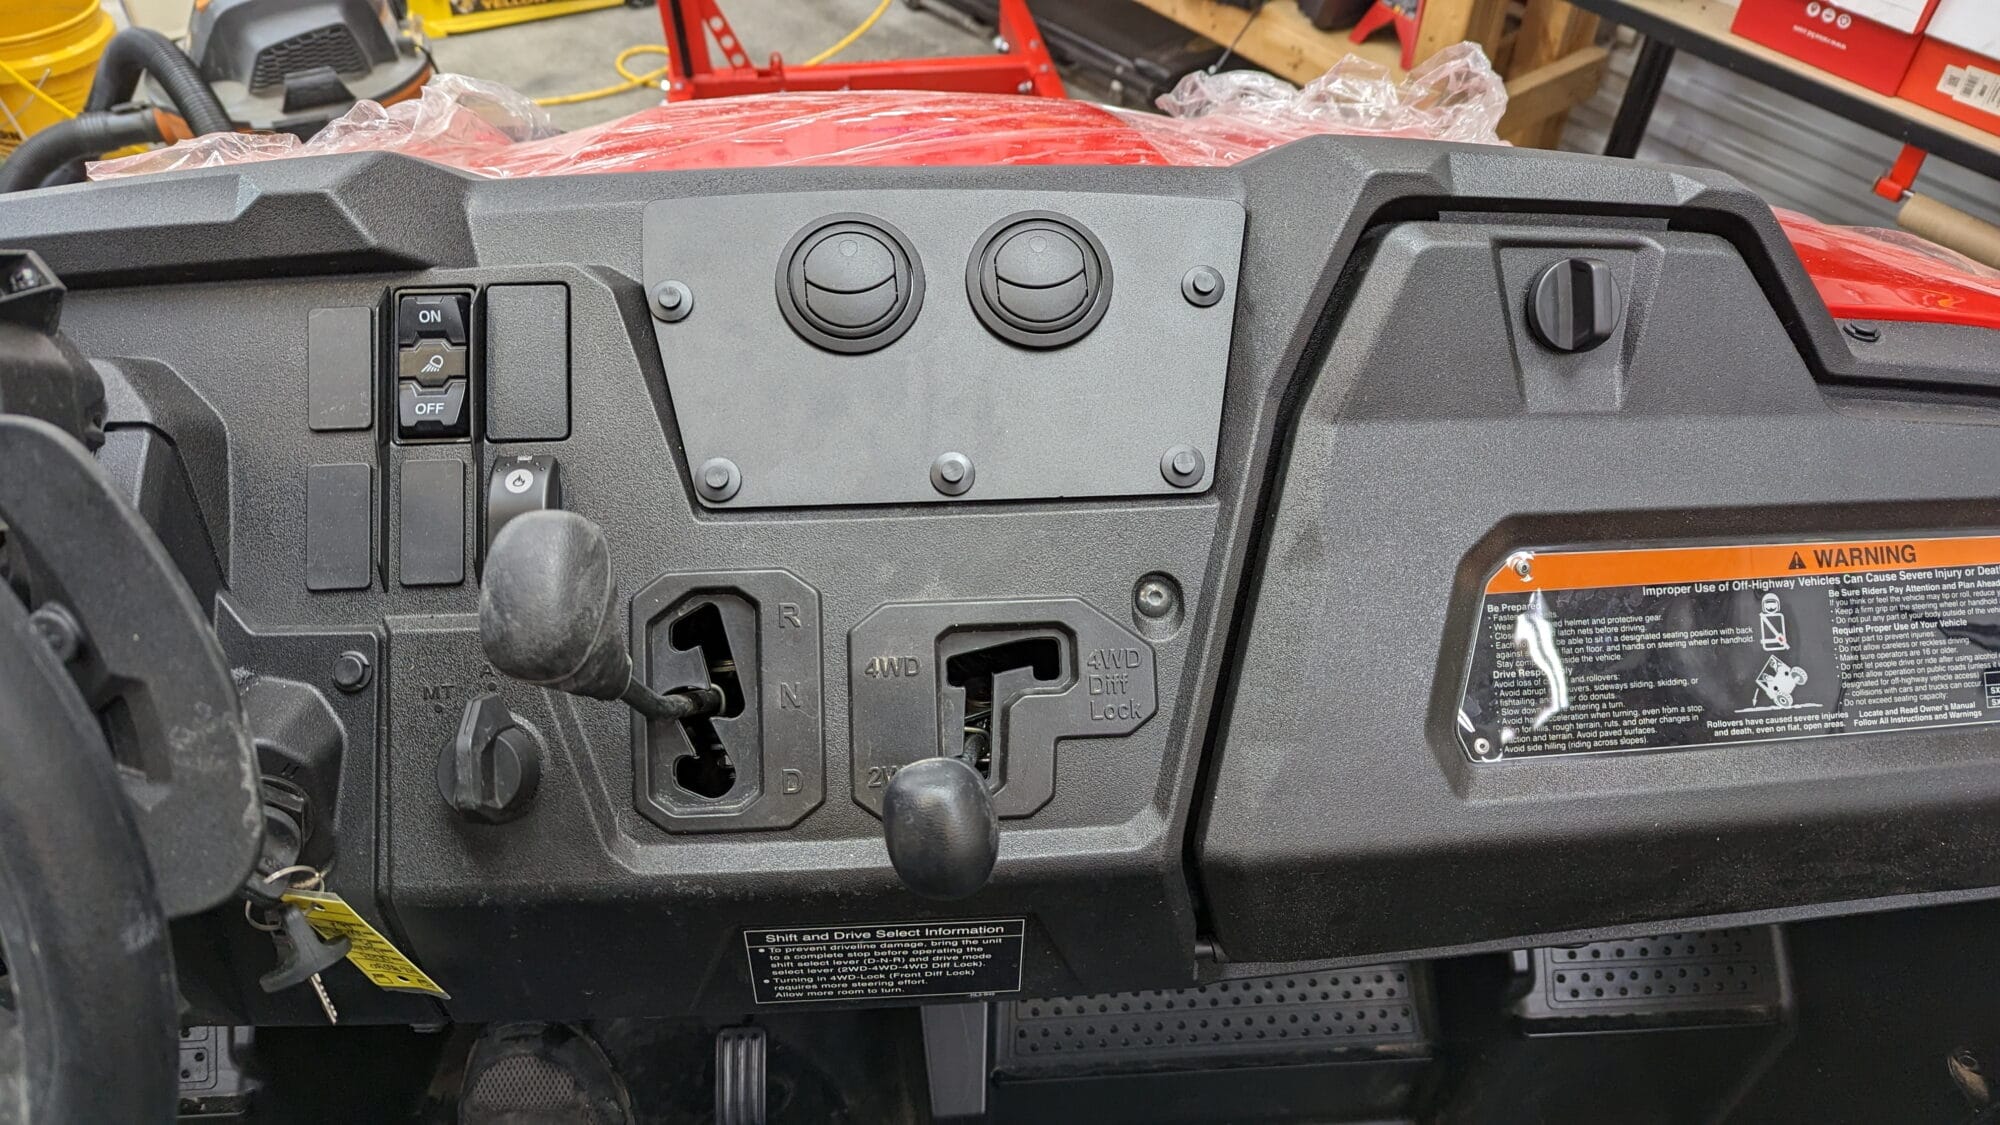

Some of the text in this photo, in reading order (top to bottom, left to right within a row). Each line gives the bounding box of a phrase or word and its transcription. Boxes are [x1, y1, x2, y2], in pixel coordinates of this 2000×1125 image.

[419, 310, 442, 323] ON
[415, 403, 444, 415] OFF
[1814, 544, 1916, 568] WARNING
[1642, 563, 2000, 597] Improper Use of Off-Highway Vehicles Can Cause Severe Injury or Deat
[1829, 578, 2000, 596] Be Sure Riders Pay Attention and Plan Ahead
[1488, 600, 1541, 612] Be Prepared
[778, 602, 801, 628] R
[1564, 617, 1589, 626] helmet
[1607, 614, 1642, 625] protective
[1645, 614, 1663, 622] gear.
[1558, 627, 1575, 635] latch
[1620, 624, 1647, 632] driving.
[1832, 617, 1967, 635] Require Proper Use of Your Vehicle
[1496, 640, 1514, 648] Each
[1620, 631, 1660, 641] designated
[1662, 629, 1688, 638] seating
[1690, 627, 1717, 638] position
[1736, 625, 1753, 633] back
[1087, 648, 1142, 669] 4WD
[1840, 652, 1858, 660] Make
[1876, 649, 1907, 659] operators
[864, 656, 921, 678] 4WD
[1493, 669, 1515, 678] Drive
[423, 683, 455, 700] MT
[1089, 674, 1128, 695] Diff
[780, 682, 801, 708] N
[1090, 698, 1142, 720] Lock
[1570, 701, 1599, 710] entering
[1860, 700, 1975, 717] Locate and Read Owner's Manual
[1707, 710, 1848, 728] Rollovers have caused severe injuries
[1854, 710, 1982, 726] Follow All Instructions and Warnings
[1532, 726, 1657, 741] and terrain. Avoid paved surfaces.
[1714, 727, 1728, 736] and
[1730, 725, 1753, 734] death,
[1787, 722, 1801, 731] flat,
[1803, 722, 1822, 731] open
[1504, 743, 1524, 752] Avoid
[1544, 741, 1565, 749] hilling
[1568, 739, 1591, 749] (riding
[1620, 735, 1648, 745] slopes).
[782, 768, 802, 794] D
[868, 765, 907, 789] 2W
[766, 924, 1004, 942] Shift and Drive Select Information
[785, 944, 825, 953] prevent
[794, 951, 842, 959] complete
[912, 946, 962, 955] operating
[838, 962, 927, 973] (2WD-4WD-4WD
[863, 956, 904, 965] (D-N-R)
[830, 972, 884, 980] 4WD-Lock
[889, 971, 920, 979] (Front
